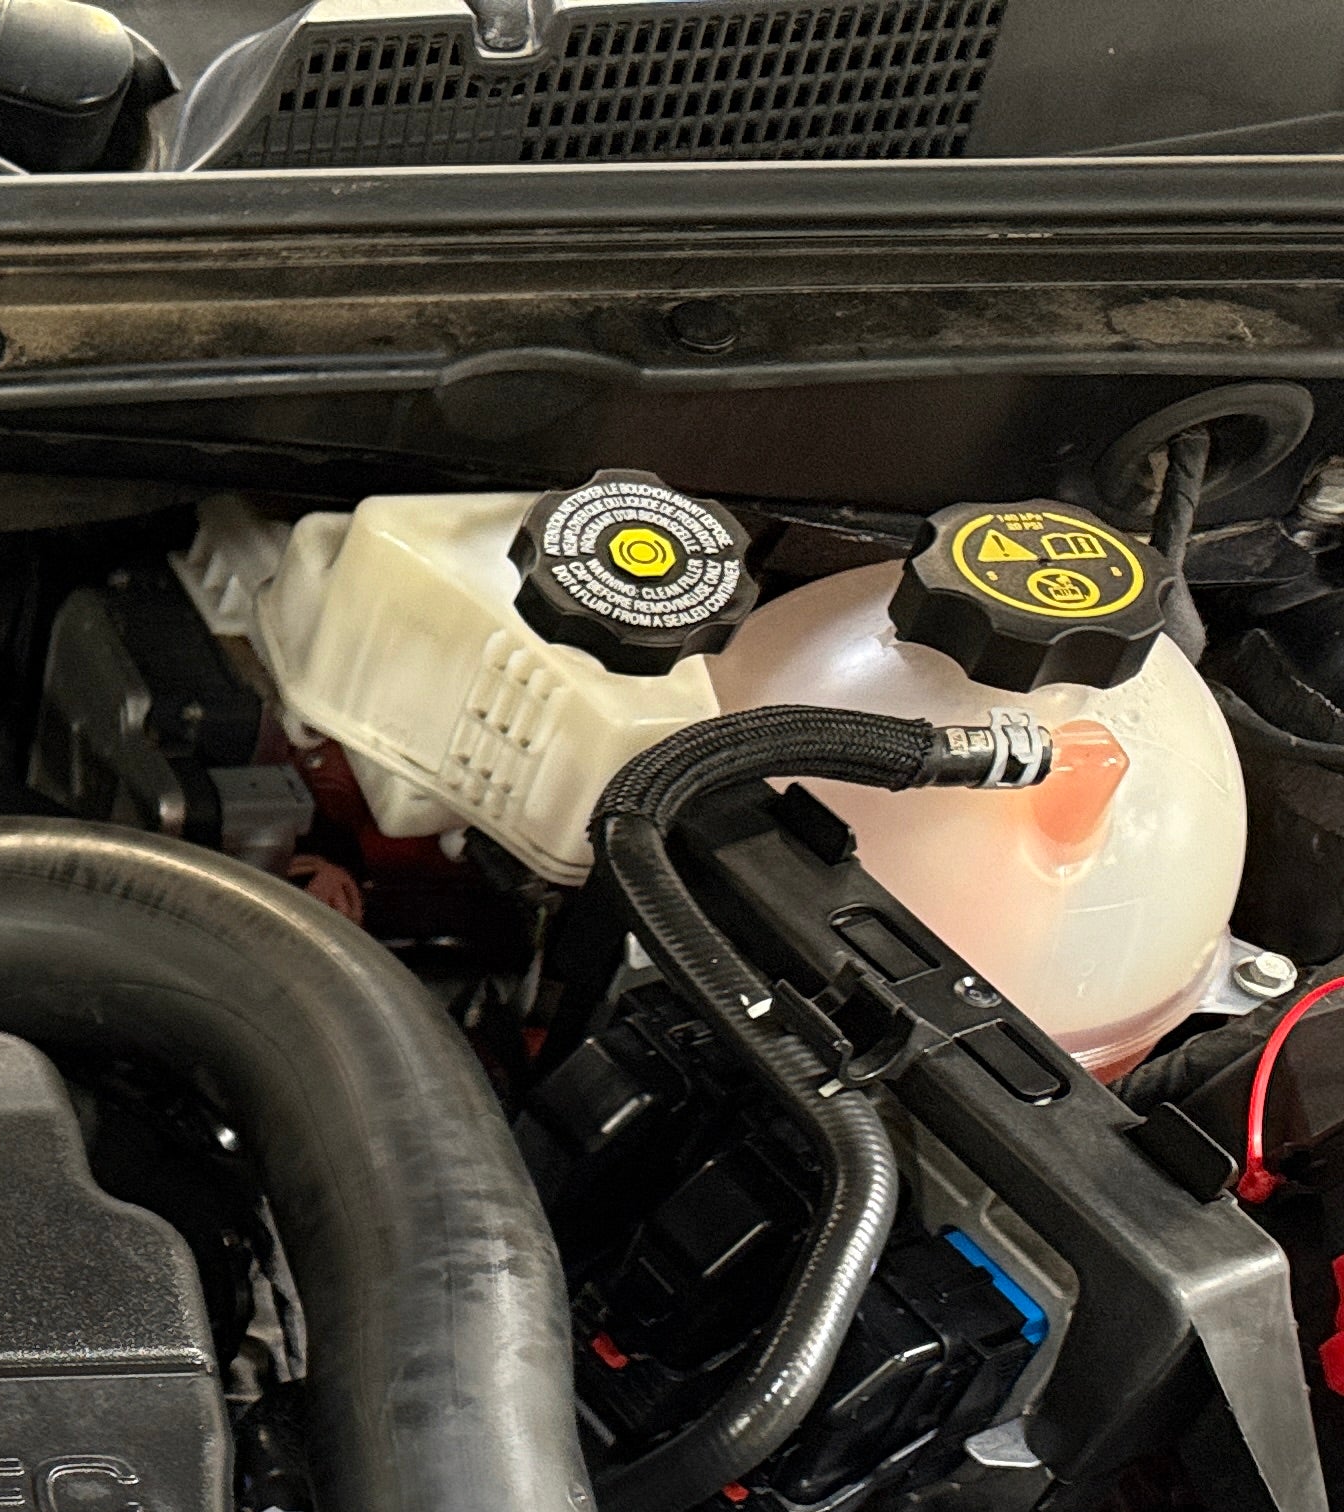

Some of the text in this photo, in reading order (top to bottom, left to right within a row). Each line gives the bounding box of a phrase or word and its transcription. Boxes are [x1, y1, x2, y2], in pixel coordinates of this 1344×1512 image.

[607, 483, 618, 494] LE
[619, 483, 670, 500] BOUCHON
[671, 494, 705, 519] AVANT
[551, 565, 577, 588] DOT
[575, 588, 613, 616] FLUID
[612, 609, 652, 627] FROM
[651, 614, 664, 628] A
[663, 606, 710, 628] SEALED
[569, 561, 594, 585] CAP
[584, 578, 633, 610] BEFORE
[690, 582, 712, 601] USE
[641, 583, 685, 599] CLEAN
[677, 559, 702, 590] FILLER
